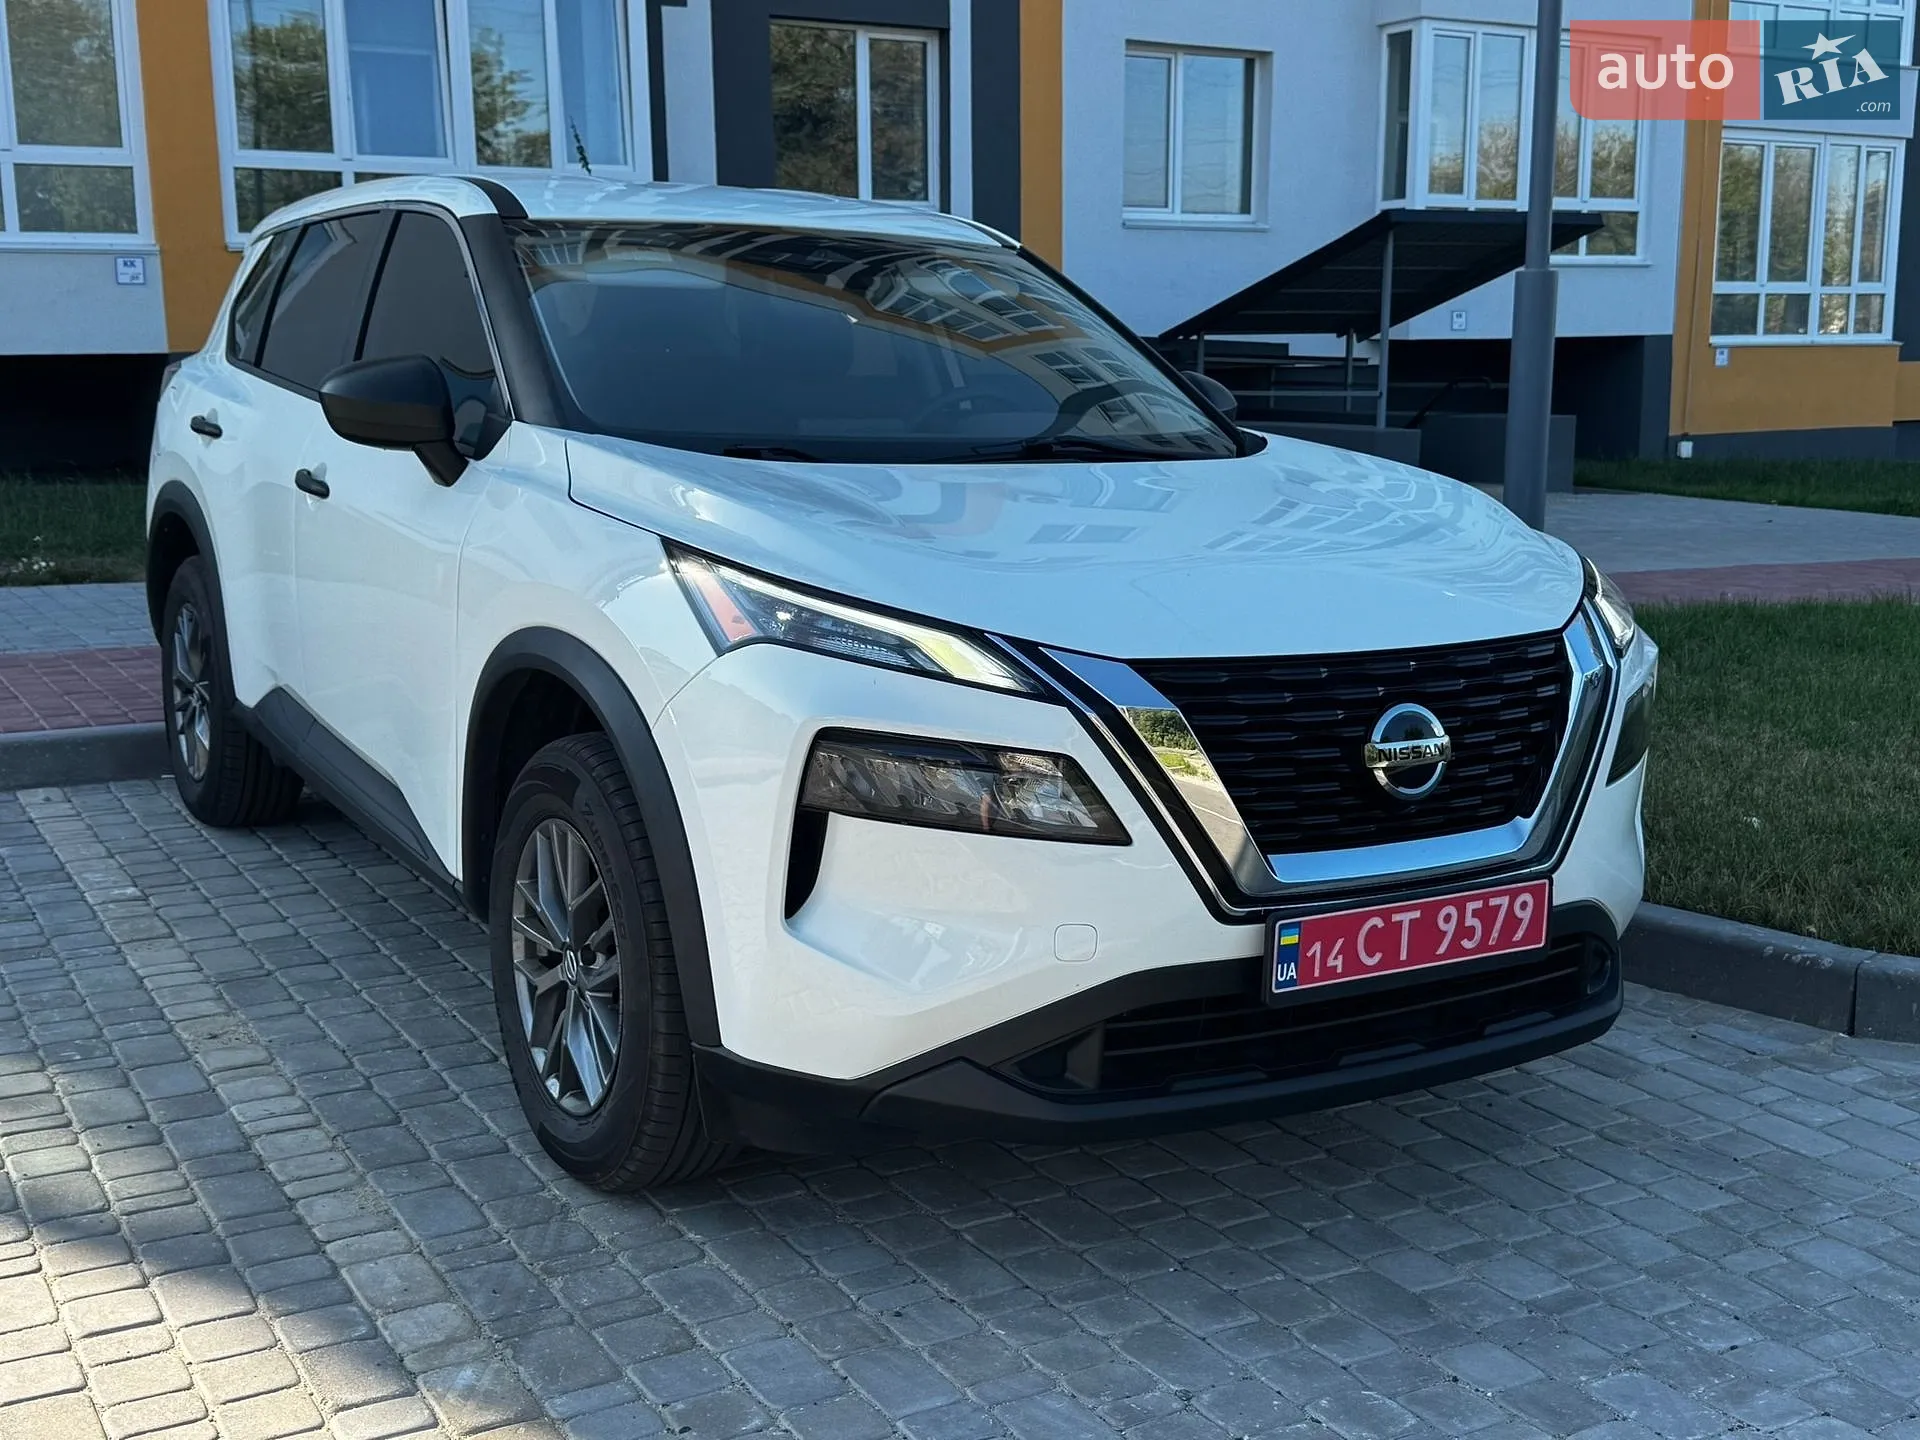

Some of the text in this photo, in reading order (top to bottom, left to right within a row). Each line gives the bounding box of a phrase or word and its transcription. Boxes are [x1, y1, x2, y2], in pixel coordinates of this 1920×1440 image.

[1377, 742, 1445, 762] NISSAN
[1306, 892, 1534, 977] 14 CT 9579
[1277, 962, 1297, 982] UA
